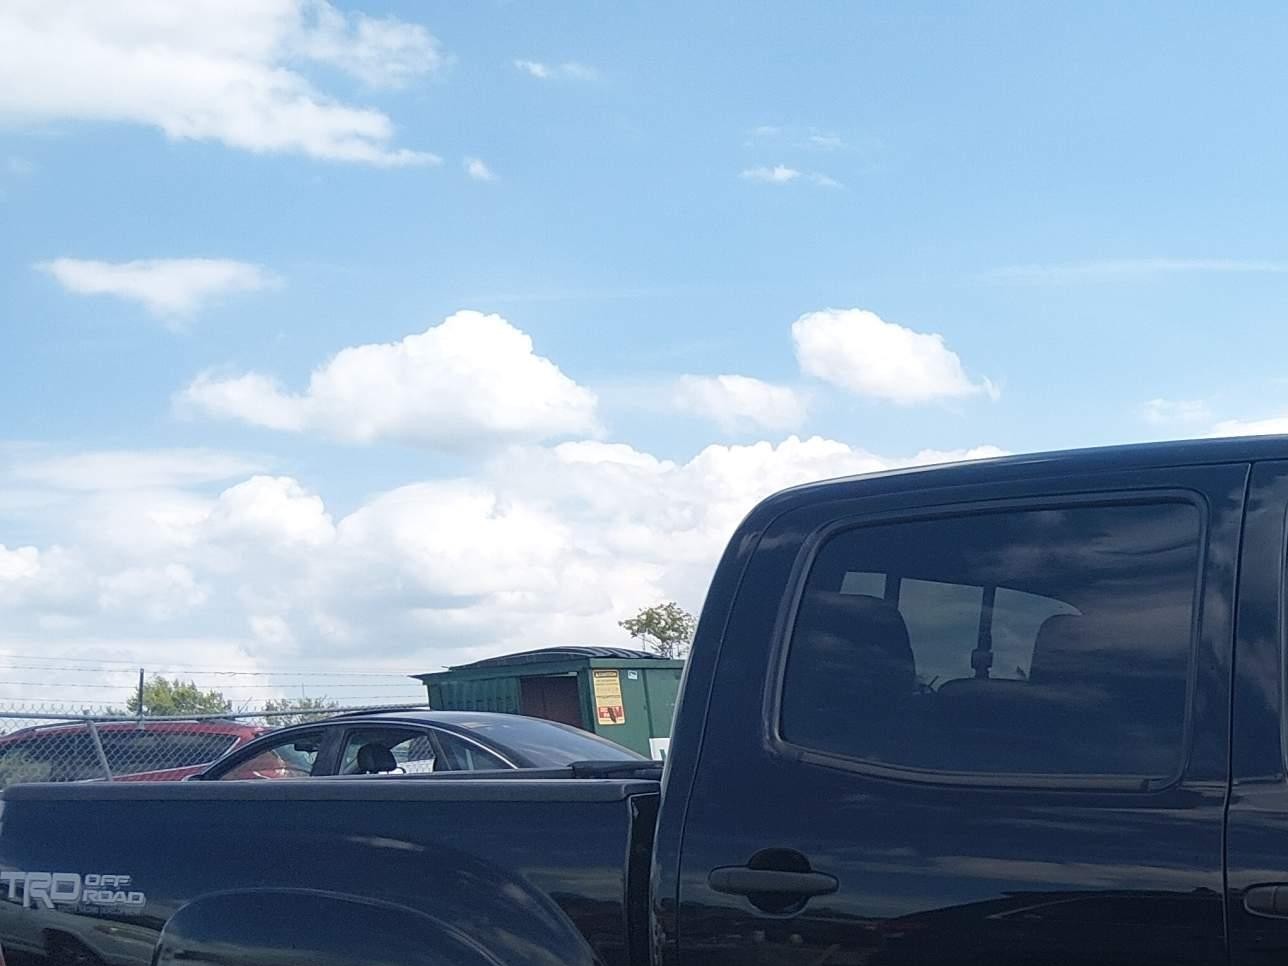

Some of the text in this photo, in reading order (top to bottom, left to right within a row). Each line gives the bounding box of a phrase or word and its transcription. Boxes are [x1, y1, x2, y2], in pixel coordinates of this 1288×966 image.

[84, 874, 132, 887] OFF
[0, 871, 81, 908] TRD
[82, 890, 146, 907] ROAD
